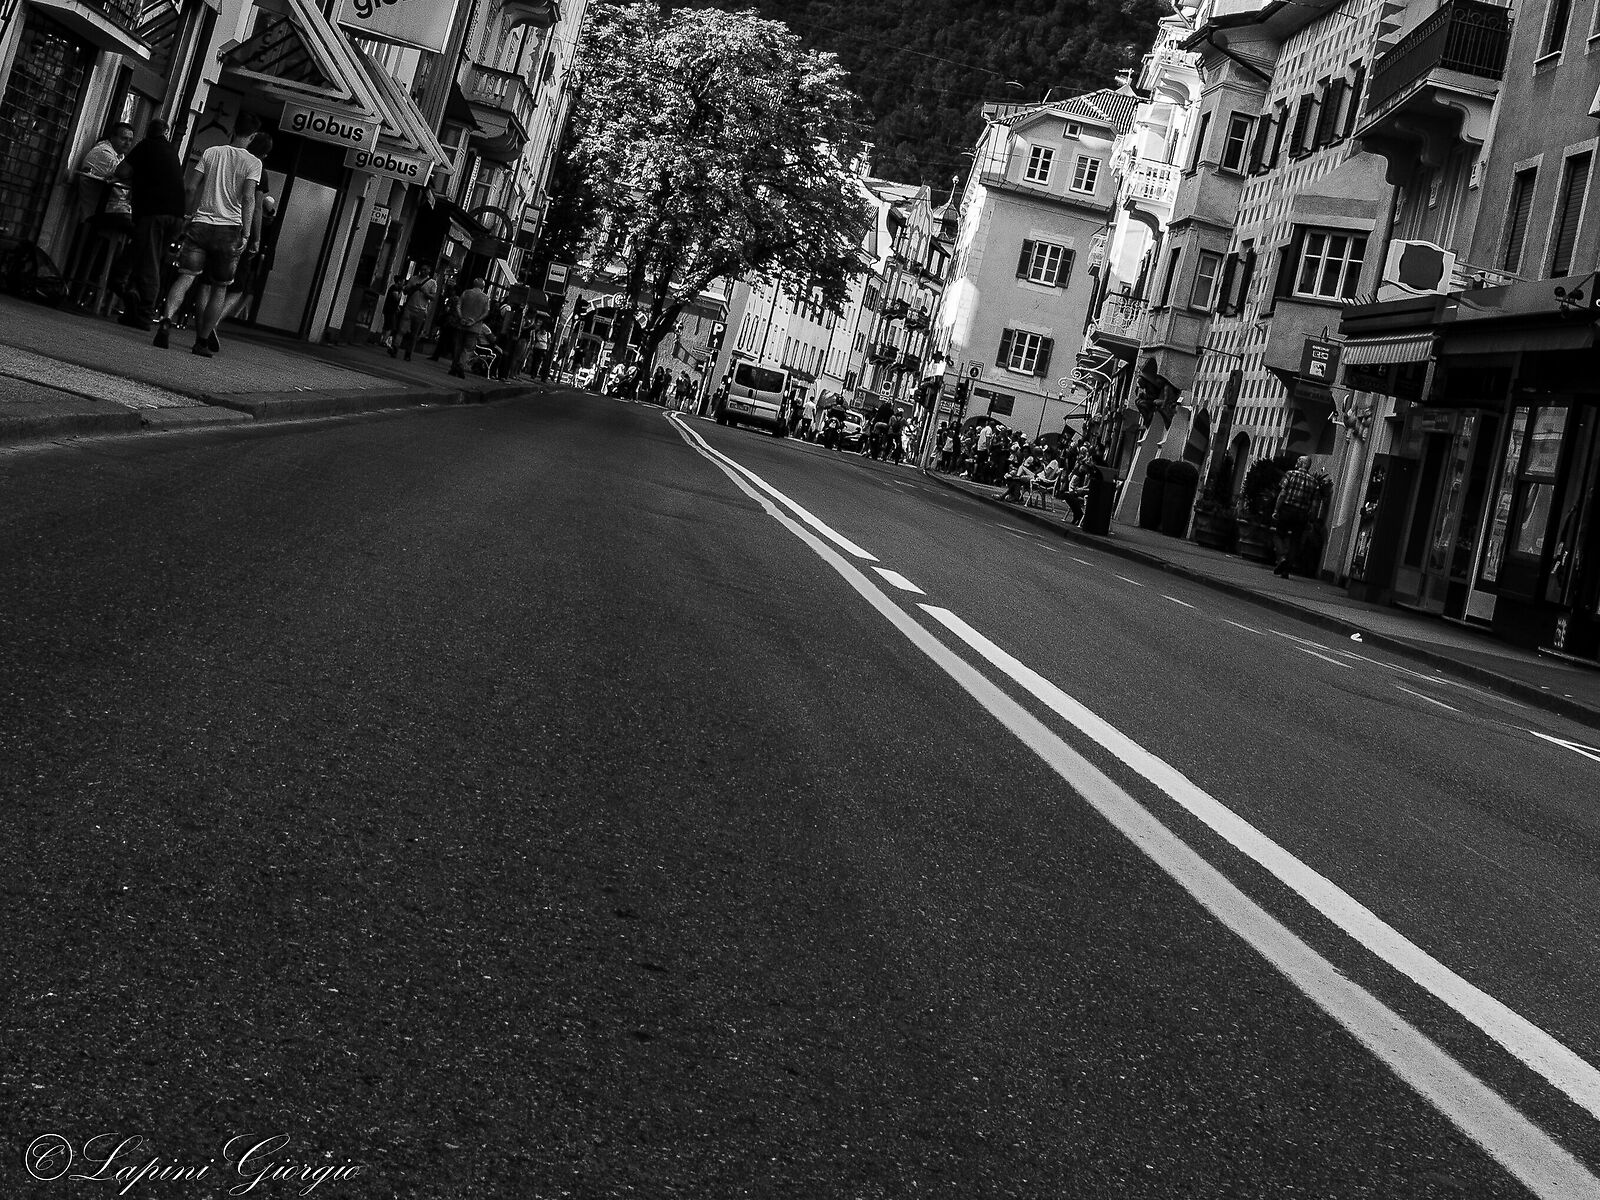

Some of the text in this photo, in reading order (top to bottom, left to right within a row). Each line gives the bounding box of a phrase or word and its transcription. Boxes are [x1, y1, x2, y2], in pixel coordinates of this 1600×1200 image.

[292, 111, 364, 142] globus
[355, 152, 418, 177] globus
[714, 324, 724, 335] P
